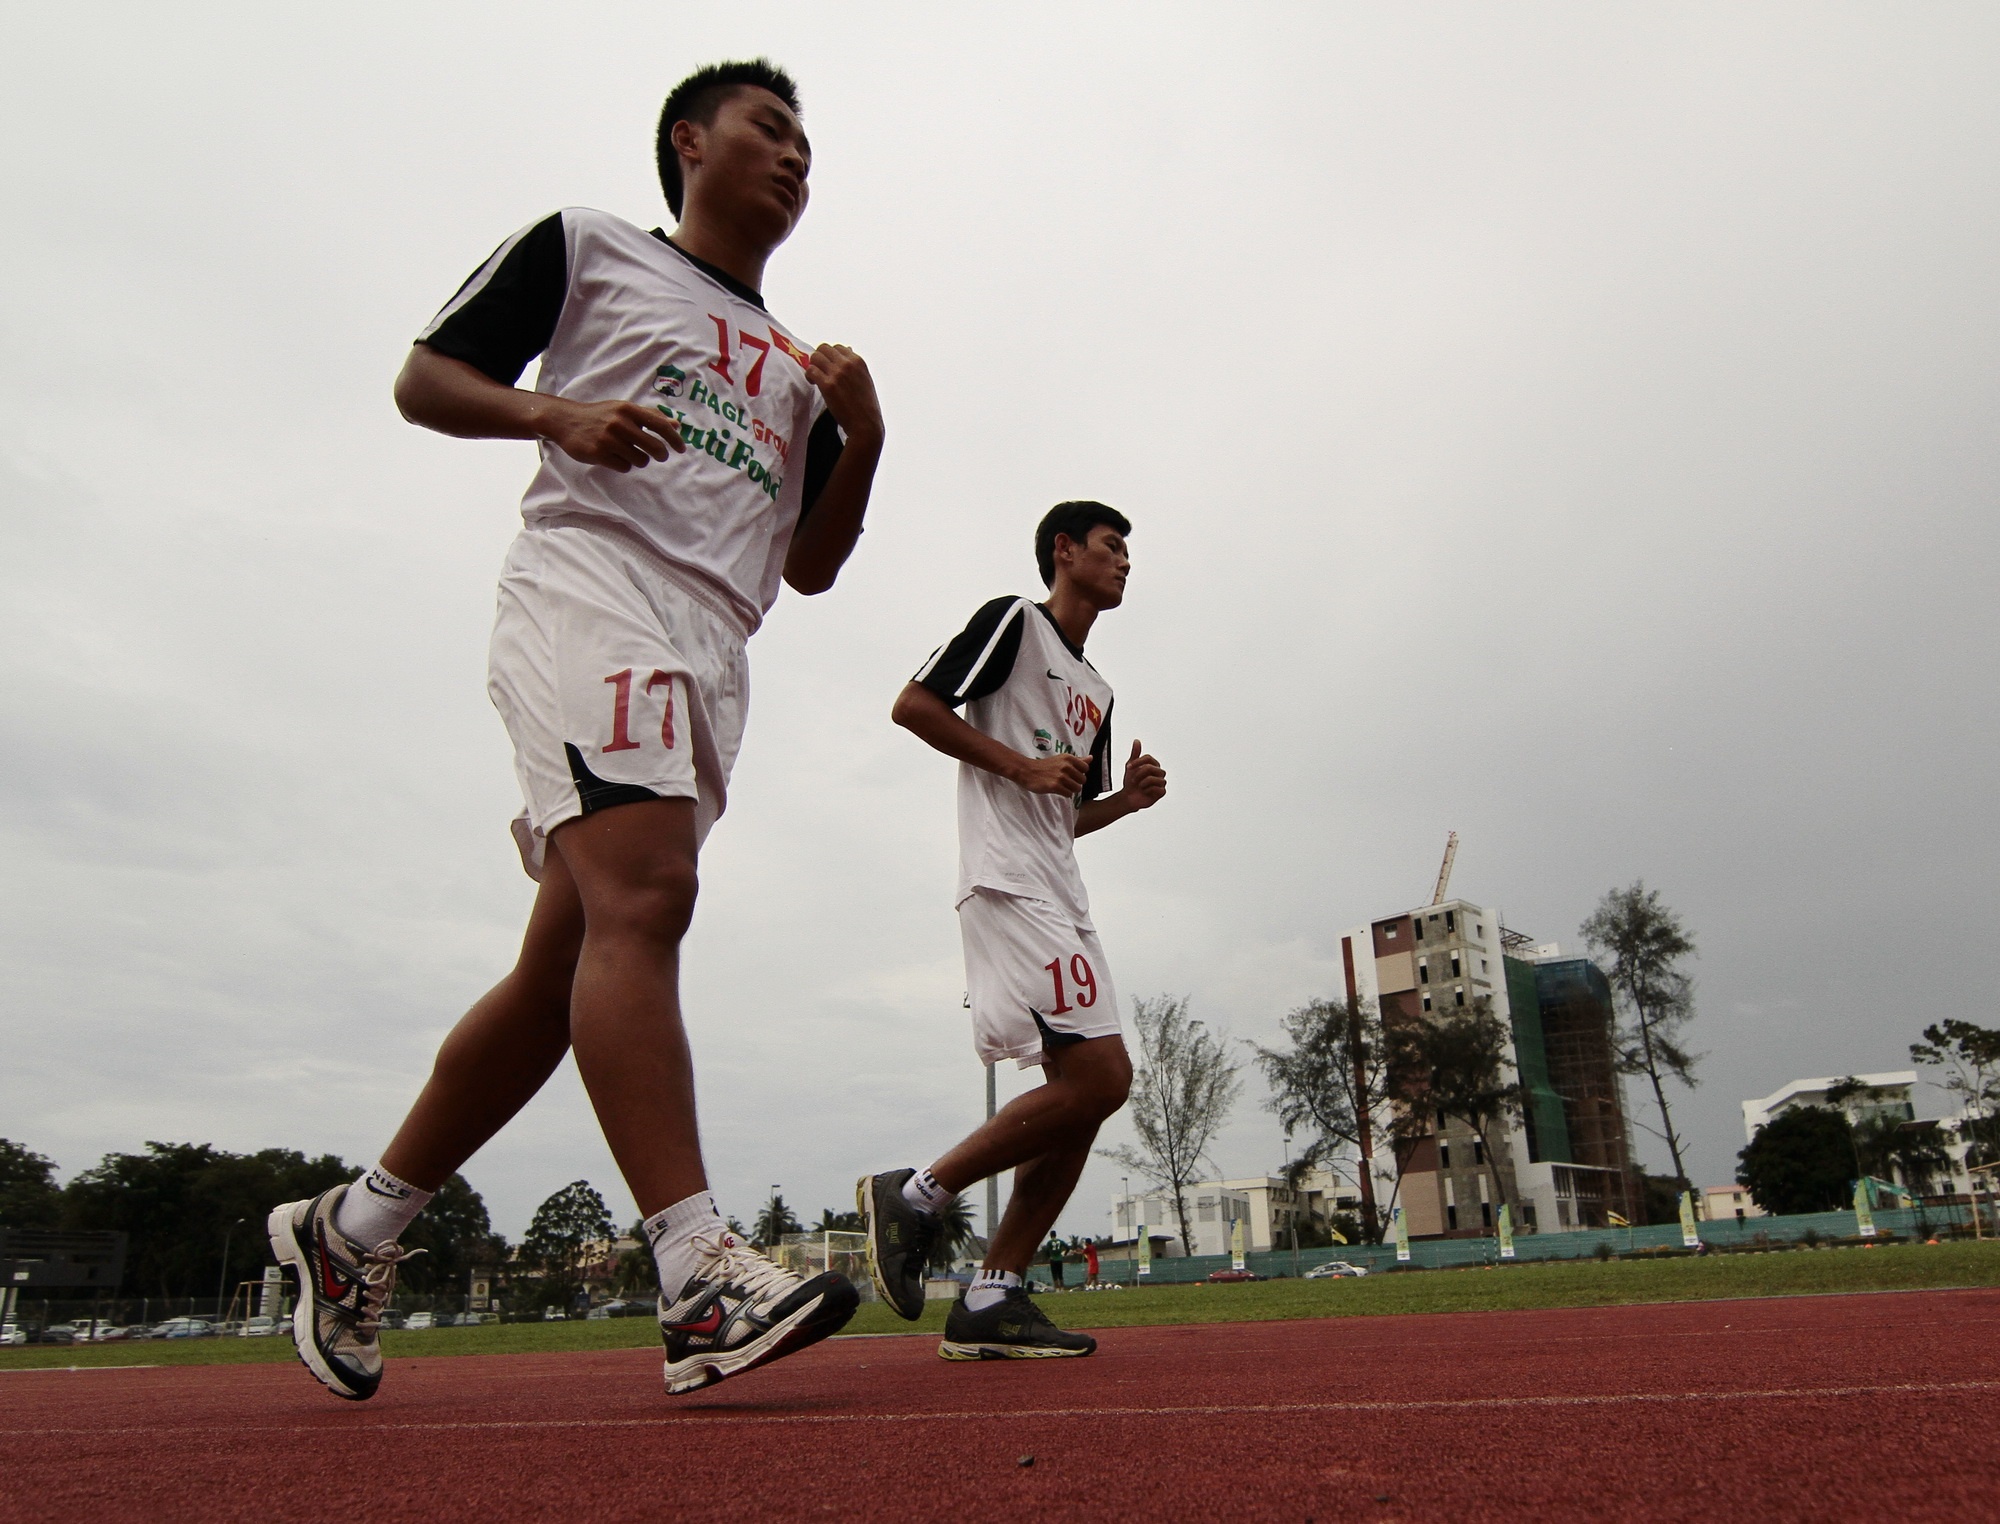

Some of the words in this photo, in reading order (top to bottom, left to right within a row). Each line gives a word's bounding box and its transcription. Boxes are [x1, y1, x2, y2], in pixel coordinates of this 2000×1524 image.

[707, 313, 771, 397] 17
[689, 379, 748, 431] HAGL
[602, 668, 675, 753] 17
[1065, 686, 1086, 737] 19
[1055, 739, 1078, 757] HA
[1044, 953, 1097, 1016] 19
[372, 1169, 411, 1198] NIKE
[647, 1219, 668, 1236] KE
